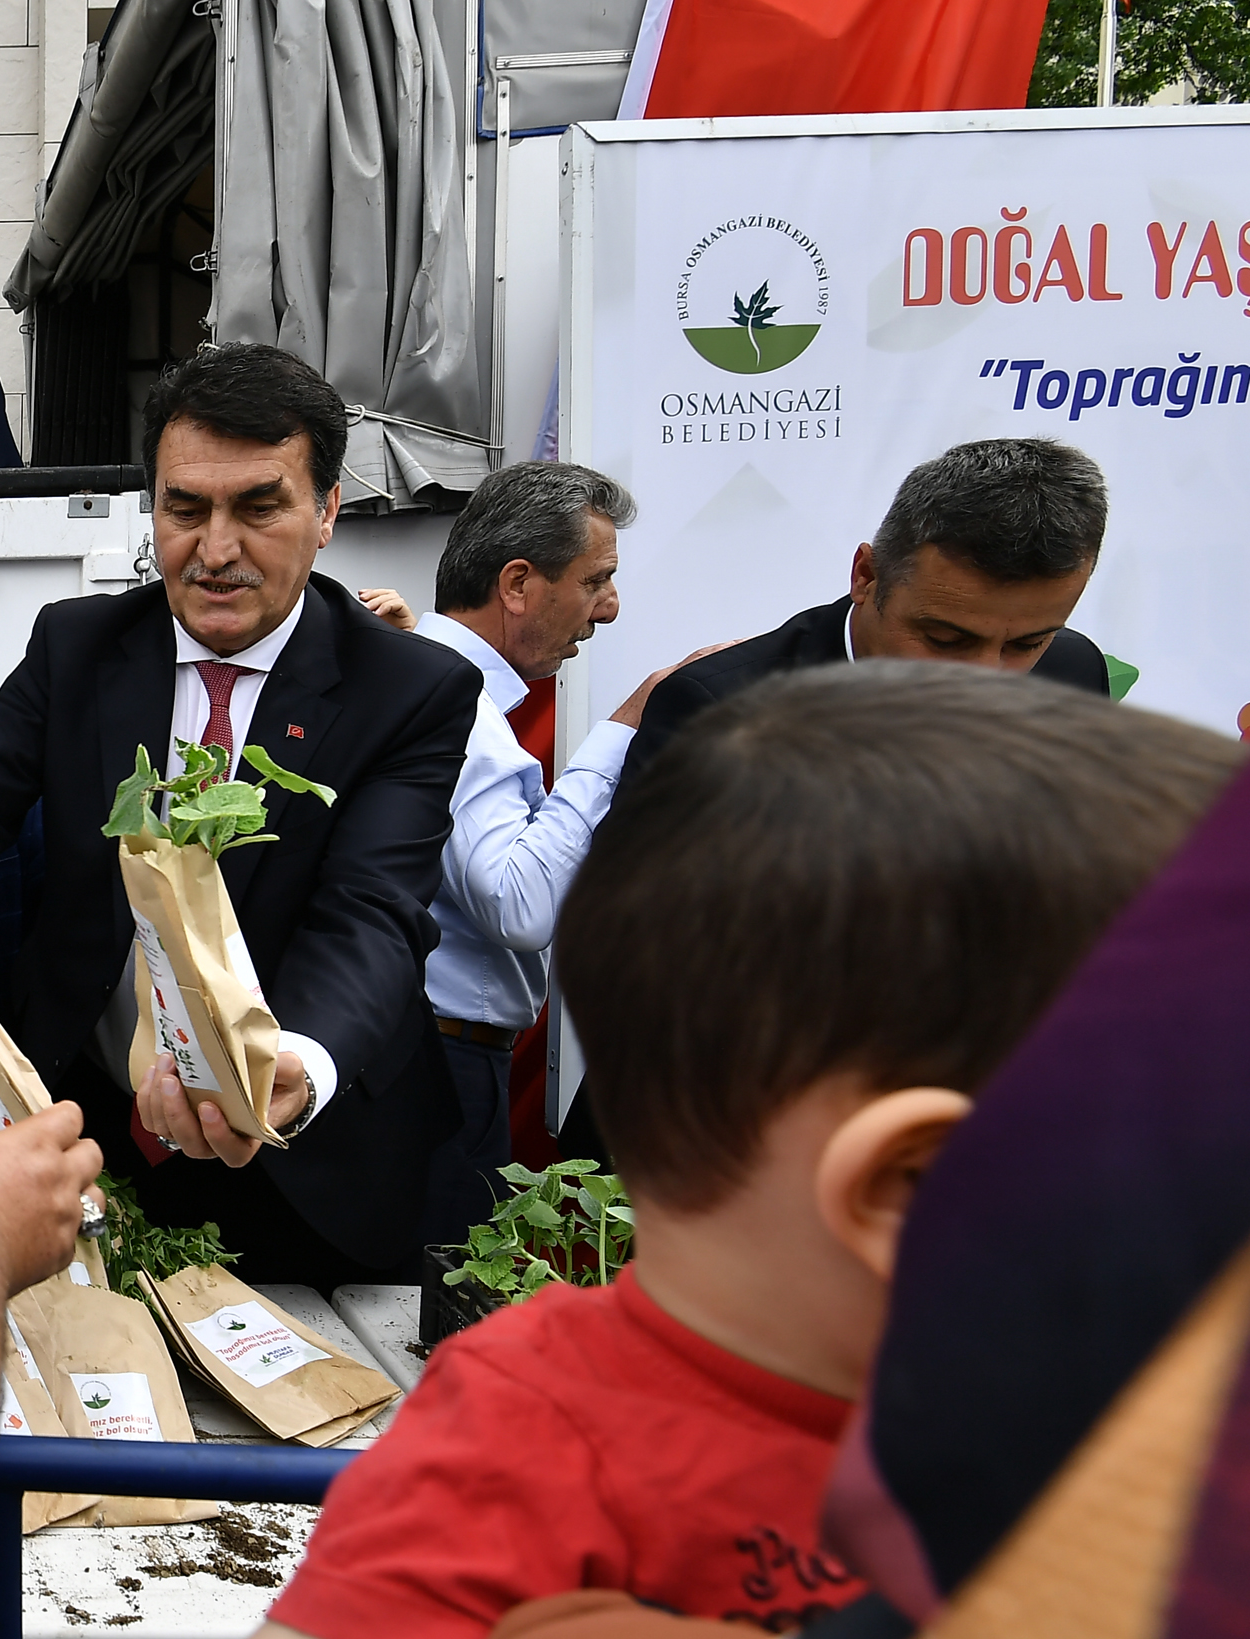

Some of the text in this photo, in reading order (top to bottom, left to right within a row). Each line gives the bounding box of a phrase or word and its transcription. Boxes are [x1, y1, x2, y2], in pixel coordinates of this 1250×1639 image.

[677, 213, 831, 321] BURSA OSMANGAZİ BELEDİYESİ 1987
[902, 206, 1124, 307] DOĞAL
[660, 384, 842, 417] OSMANGAZİ
[661, 416, 842, 445] BELEDİYESİ
[106, 1425, 121, 1436] bol
[109, 1414, 153, 1425] bereketli,
